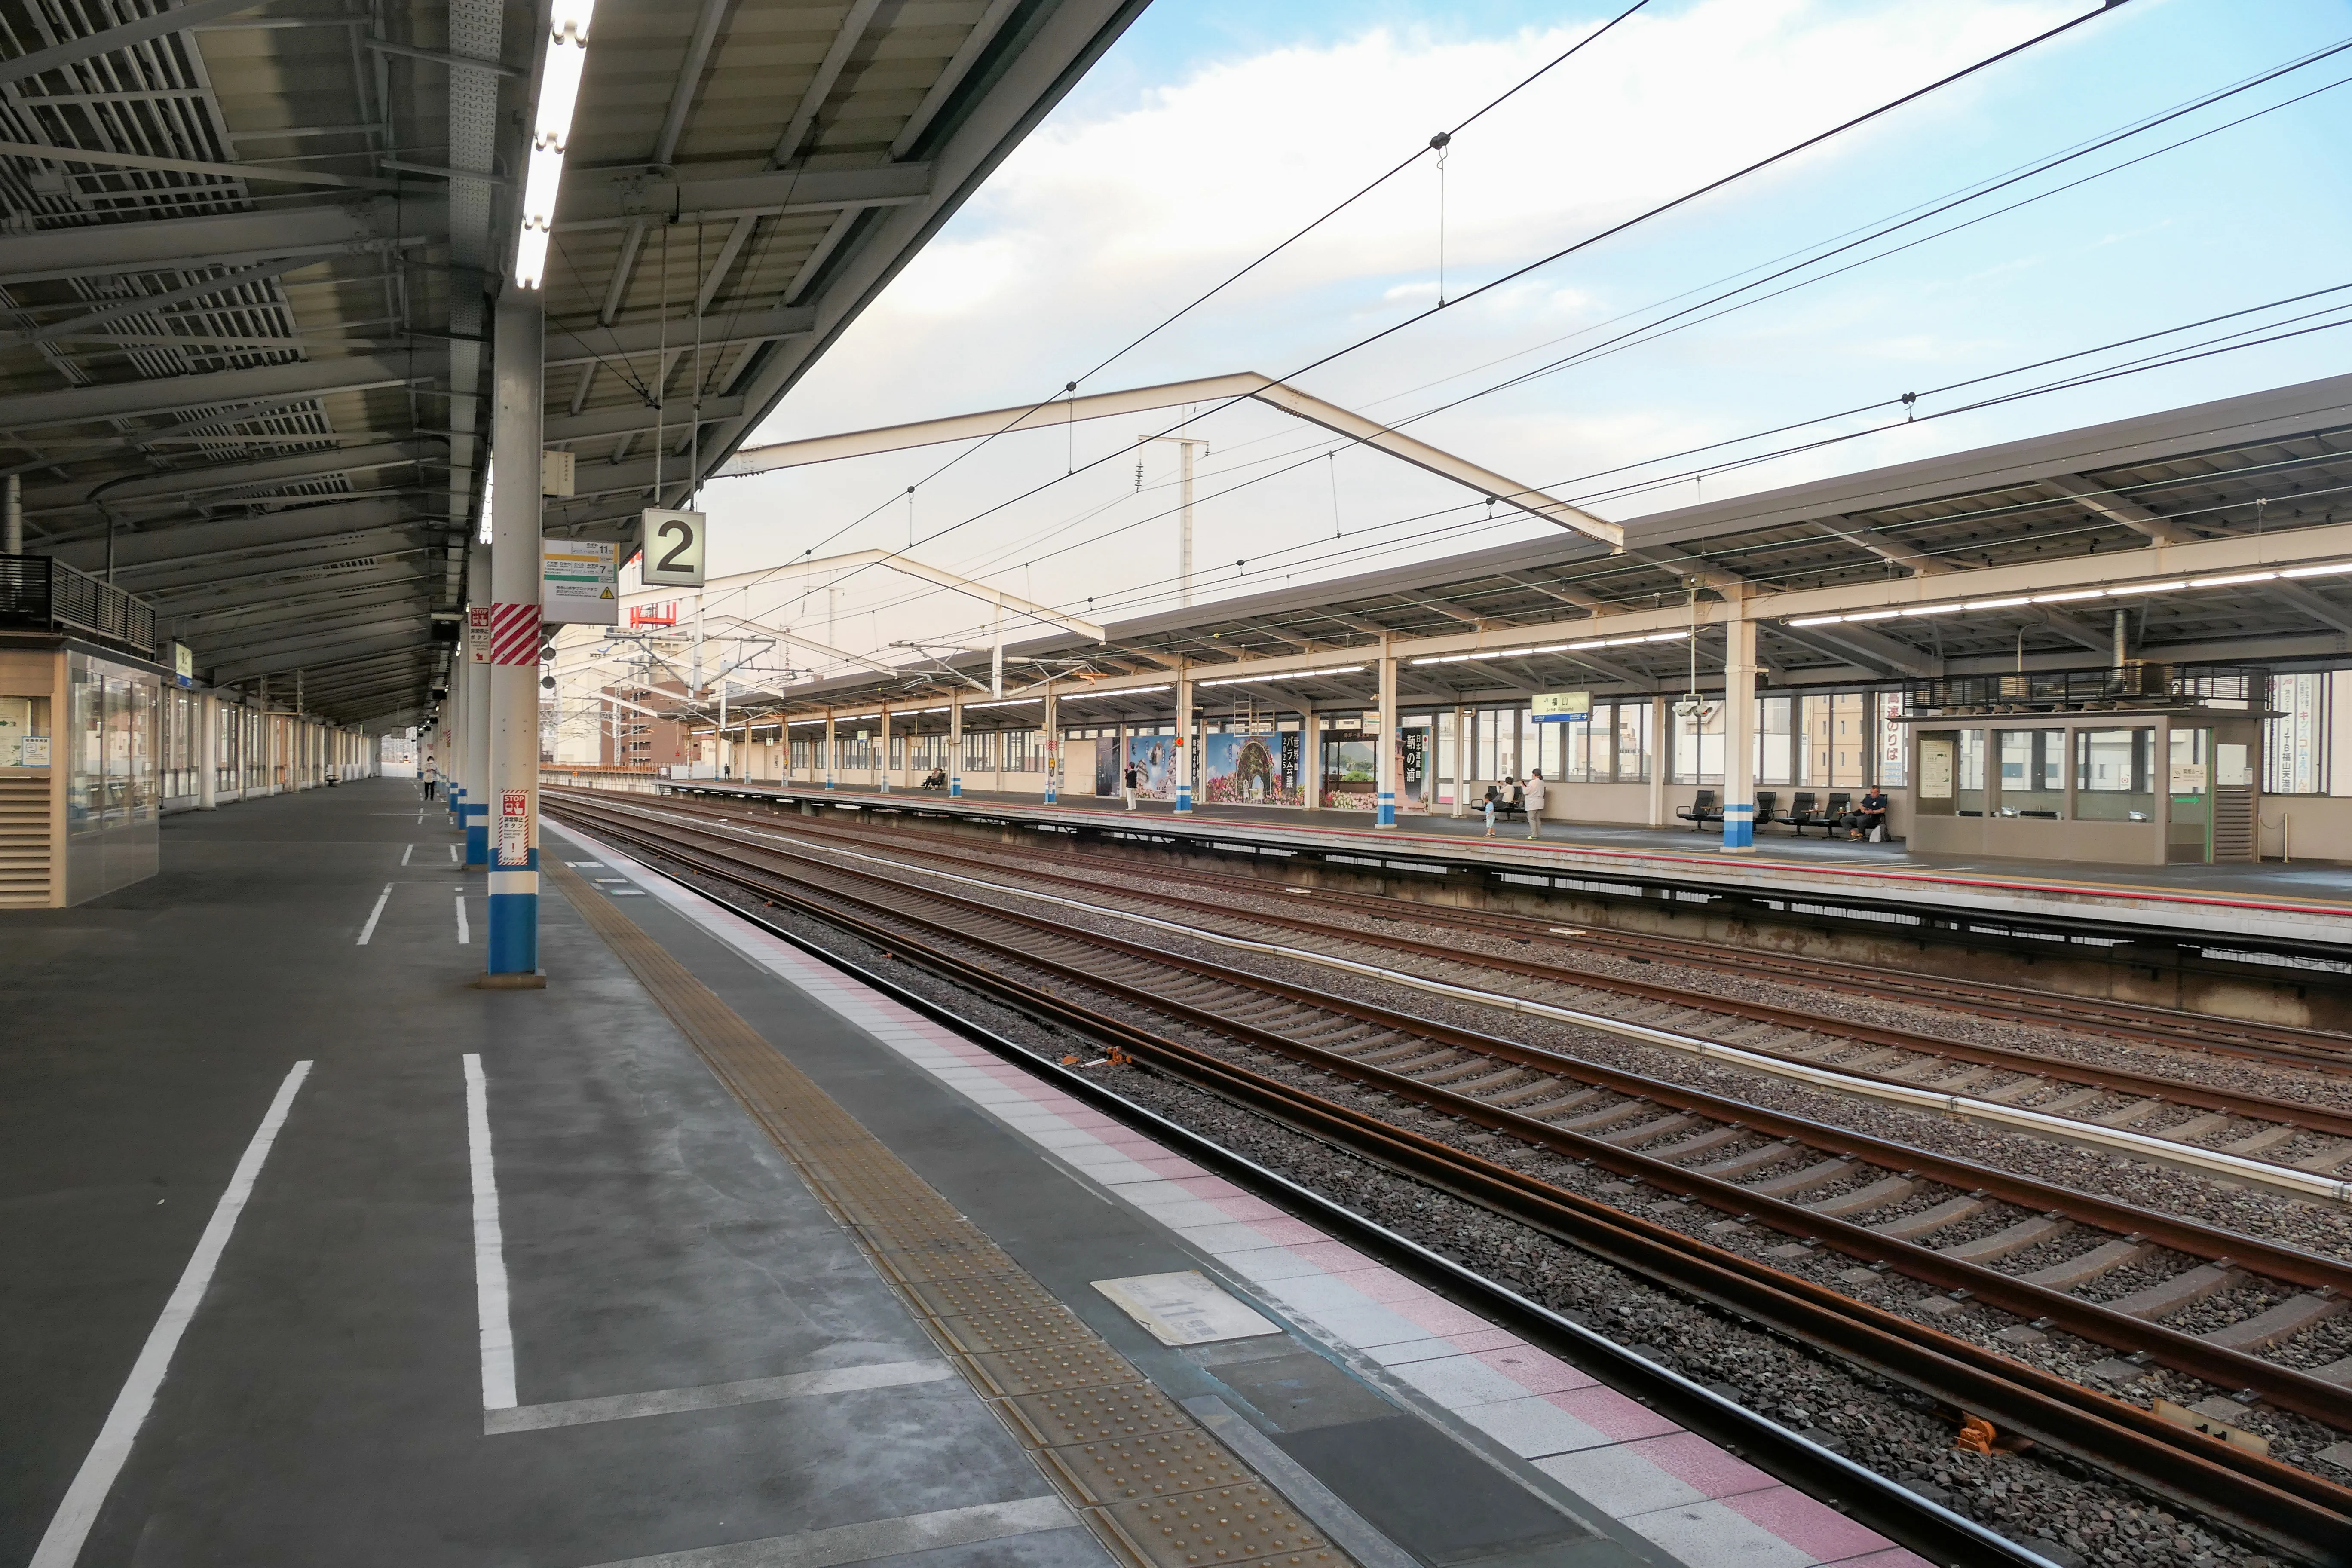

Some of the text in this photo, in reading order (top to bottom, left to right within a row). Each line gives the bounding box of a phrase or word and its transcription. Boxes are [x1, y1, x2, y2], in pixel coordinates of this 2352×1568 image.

[599, 545, 607, 554] 11
[656, 520, 694, 573] 2
[1552, 697, 1568, 706] 福山
[1887, 693, 1899, 760] 高速のりば
[1294, 737, 1299, 760] 世界
[1407, 735, 1415, 782] 鞆の浦
[1149, 1298, 1207, 1318] 11
[1186, 1320, 1218, 1336] 号車
